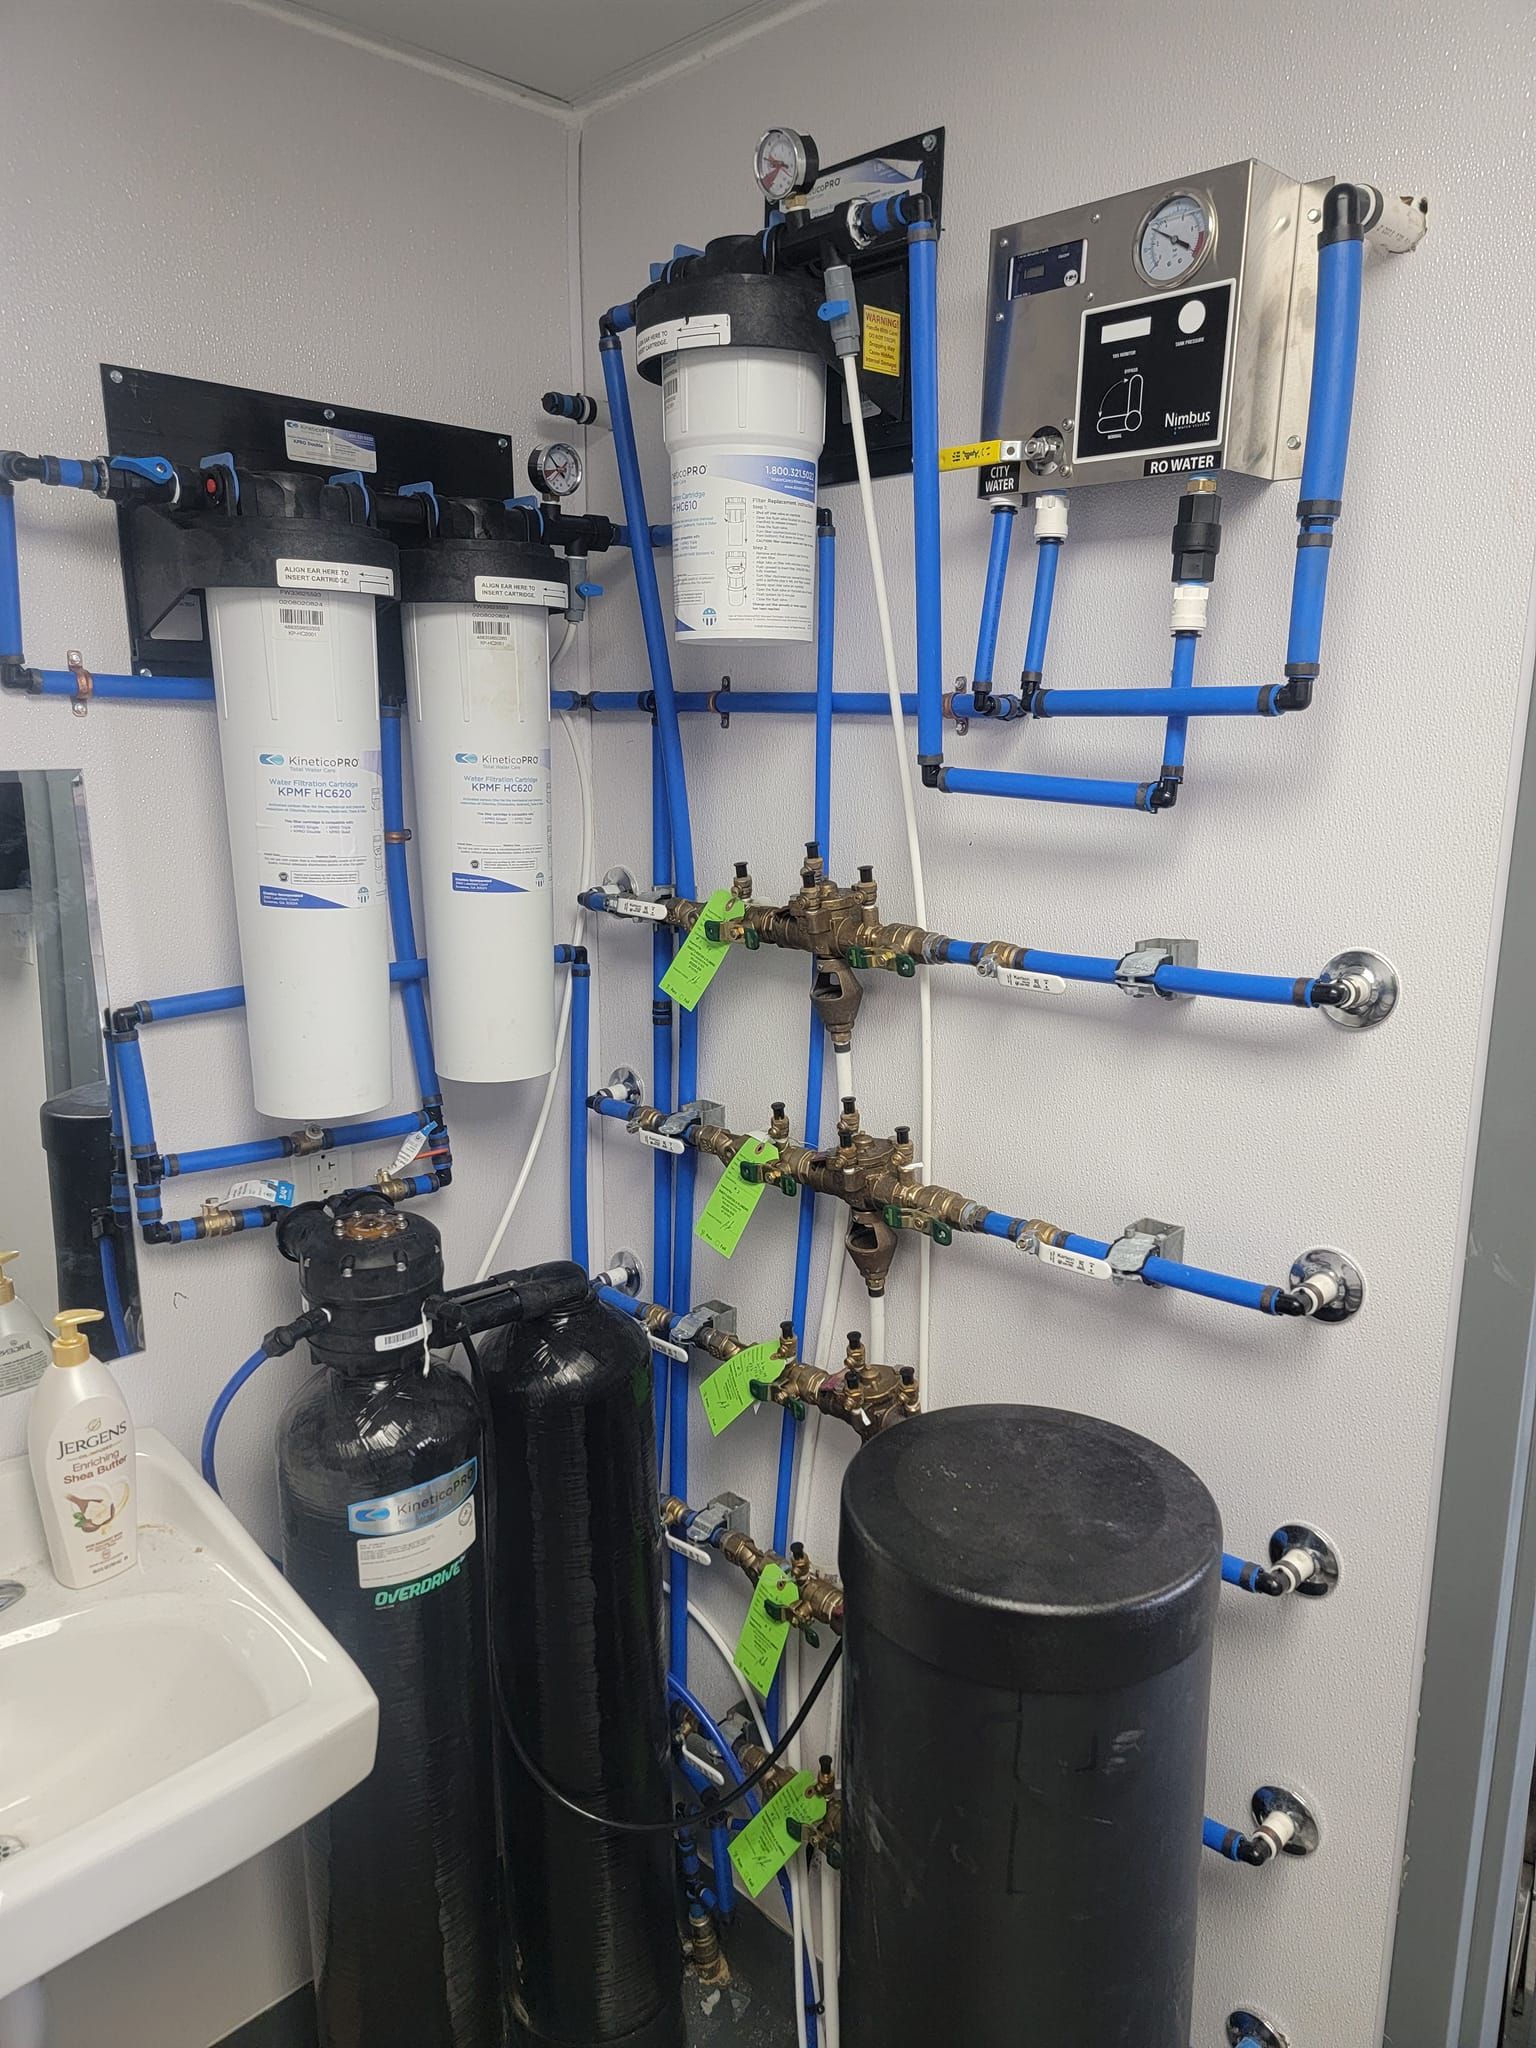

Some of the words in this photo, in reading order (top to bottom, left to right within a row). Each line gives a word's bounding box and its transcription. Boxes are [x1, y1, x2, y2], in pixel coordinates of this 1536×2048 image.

[1164, 411, 1211, 429] Nimbus
[990, 465, 1011, 479] CITY
[1150, 460, 1169, 474] RO
[1170, 454, 1214, 472] WATER
[985, 478, 1015, 492] WATER
[288, 756, 359, 768] KineticoPRO
[481, 755, 539, 765] KineticoPRO
[293, 779, 327, 787] Filtration
[328, 781, 358, 789] Cartridge
[471, 783, 501, 792] KPMF
[503, 784, 533, 792] HC620
[278, 787, 312, 797] KPMF
[315, 789, 352, 798] HC620
[56, 1420, 127, 1460] JERGENS
[63, 1471, 94, 1484] Shea
[97, 1454, 128, 1475] Butter
[72, 1450, 120, 1472] Enriching
[397, 1467, 474, 1517] KineticoPRO
[374, 1560, 462, 1607] OVERDRIVE
